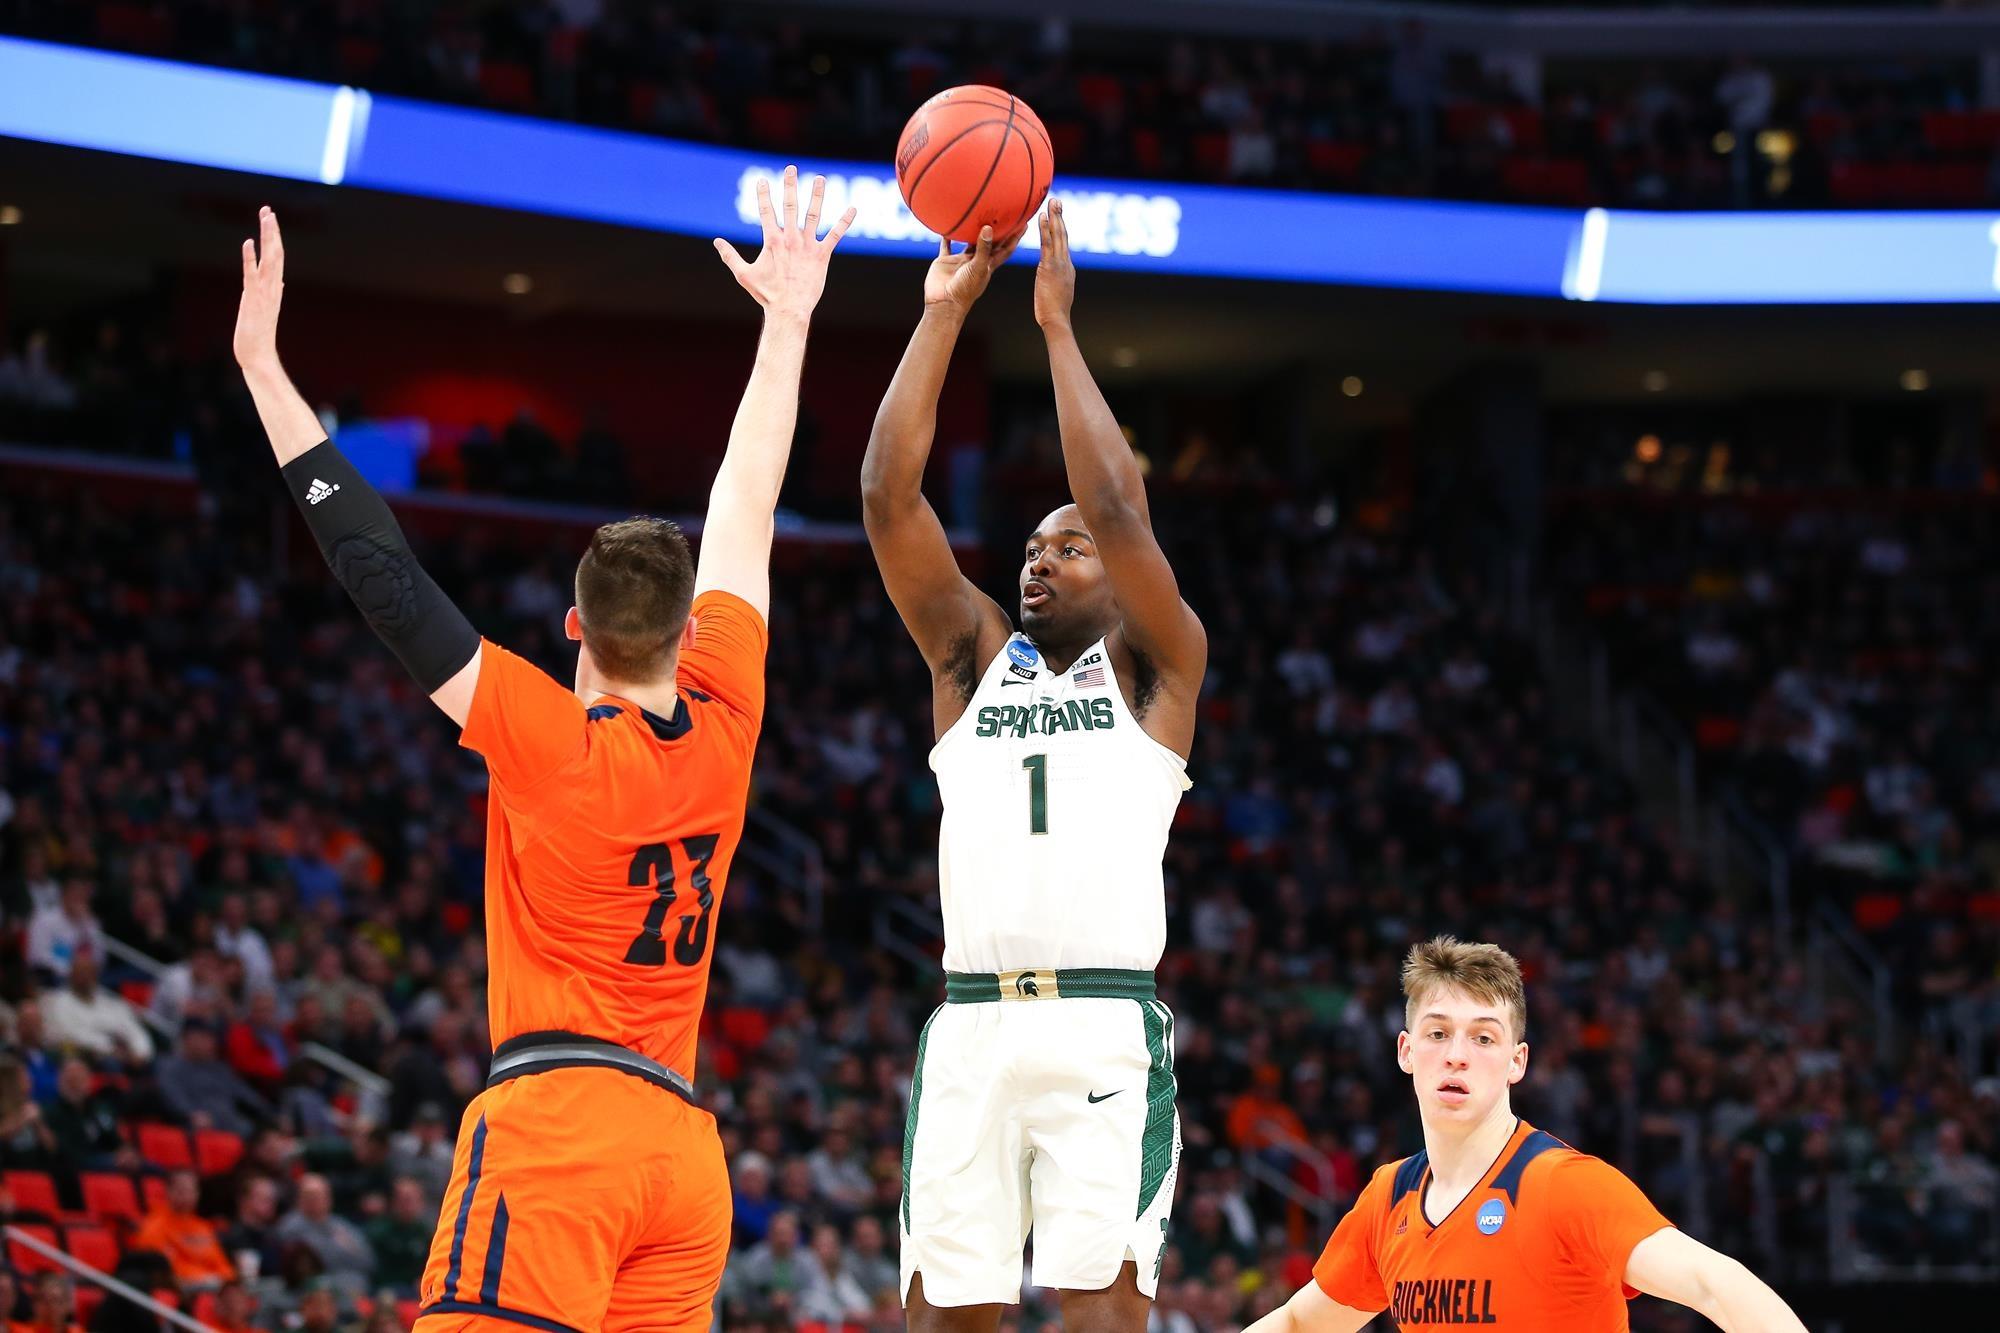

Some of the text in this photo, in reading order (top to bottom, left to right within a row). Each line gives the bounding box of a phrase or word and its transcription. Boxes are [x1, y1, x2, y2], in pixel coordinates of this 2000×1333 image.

[1009, 647, 1035, 666] NCAA
[976, 697, 1115, 738] SPARTANS
[1022, 753, 1048, 835] 1
[622, 833, 720, 966] 23
[1479, 1215, 1503, 1226] NCAA
[1392, 1279, 1496, 1325] BUCKNELL
